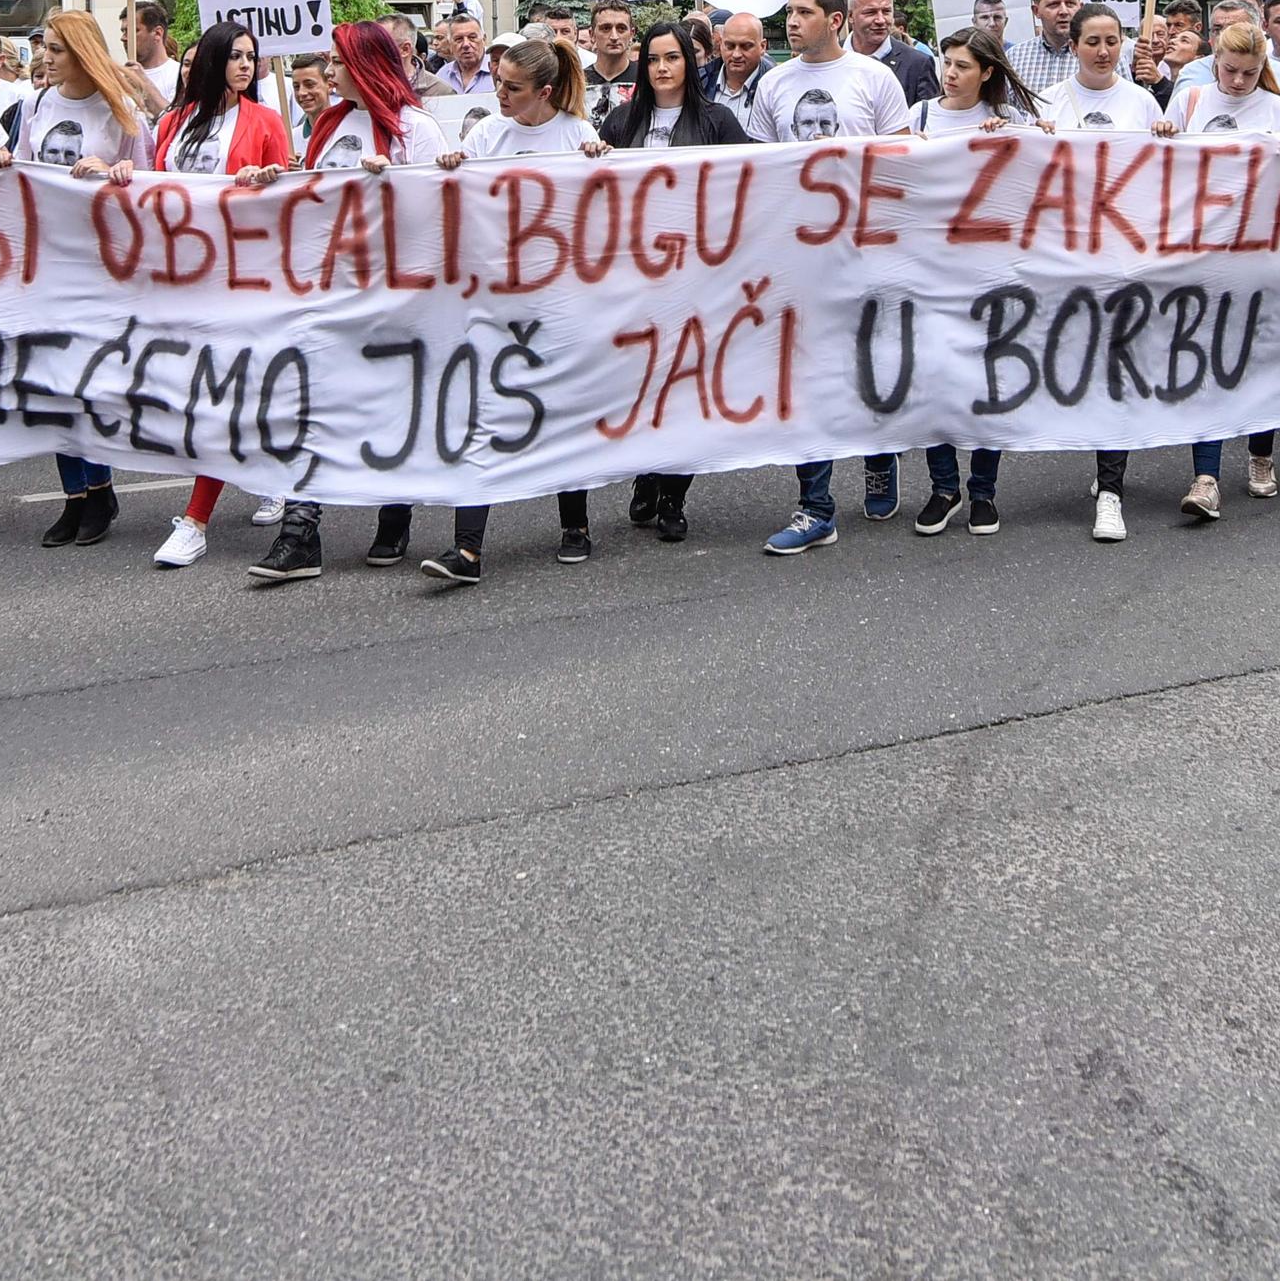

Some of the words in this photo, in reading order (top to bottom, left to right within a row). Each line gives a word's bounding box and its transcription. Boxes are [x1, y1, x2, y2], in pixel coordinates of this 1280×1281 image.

[489, 160, 754, 297] BOGU
[795, 143, 911, 249] SE
[361, 320, 546, 471] JOŠ
[597, 276, 795, 440] JAČI
[856, 298, 915, 415] U
[971, 282, 1263, 415] BORBU
